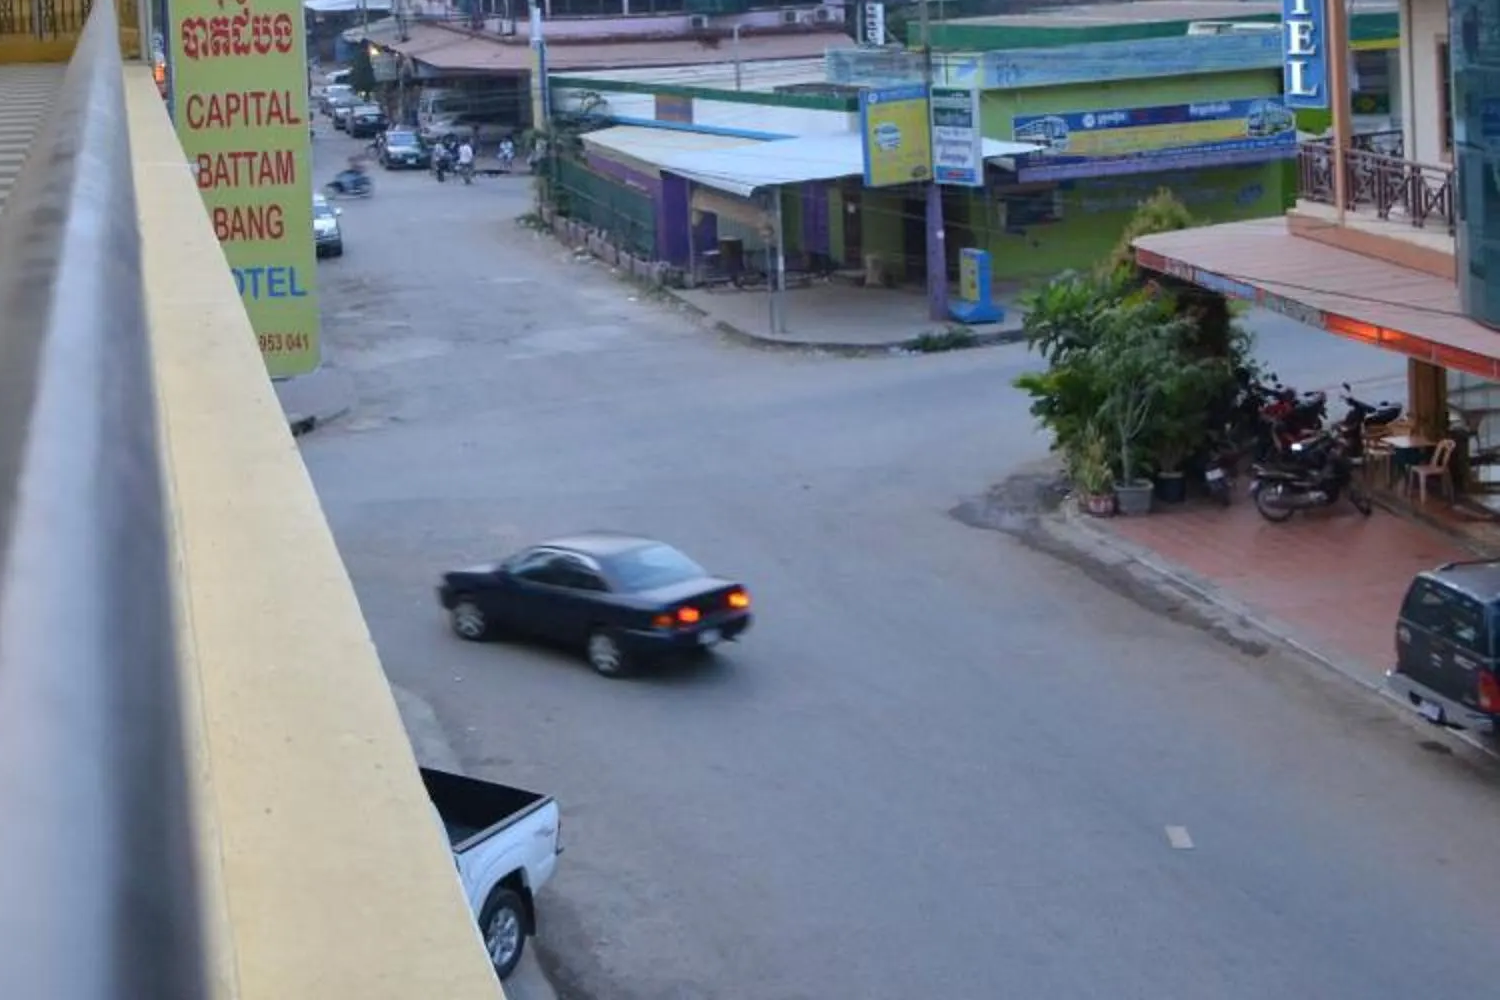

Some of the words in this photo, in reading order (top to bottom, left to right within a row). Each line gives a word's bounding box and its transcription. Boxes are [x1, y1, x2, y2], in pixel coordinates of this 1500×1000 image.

[186, 89, 302, 130] CAPITAL
[197, 149, 296, 188] BATTAM
[213, 203, 285, 241] BANG
